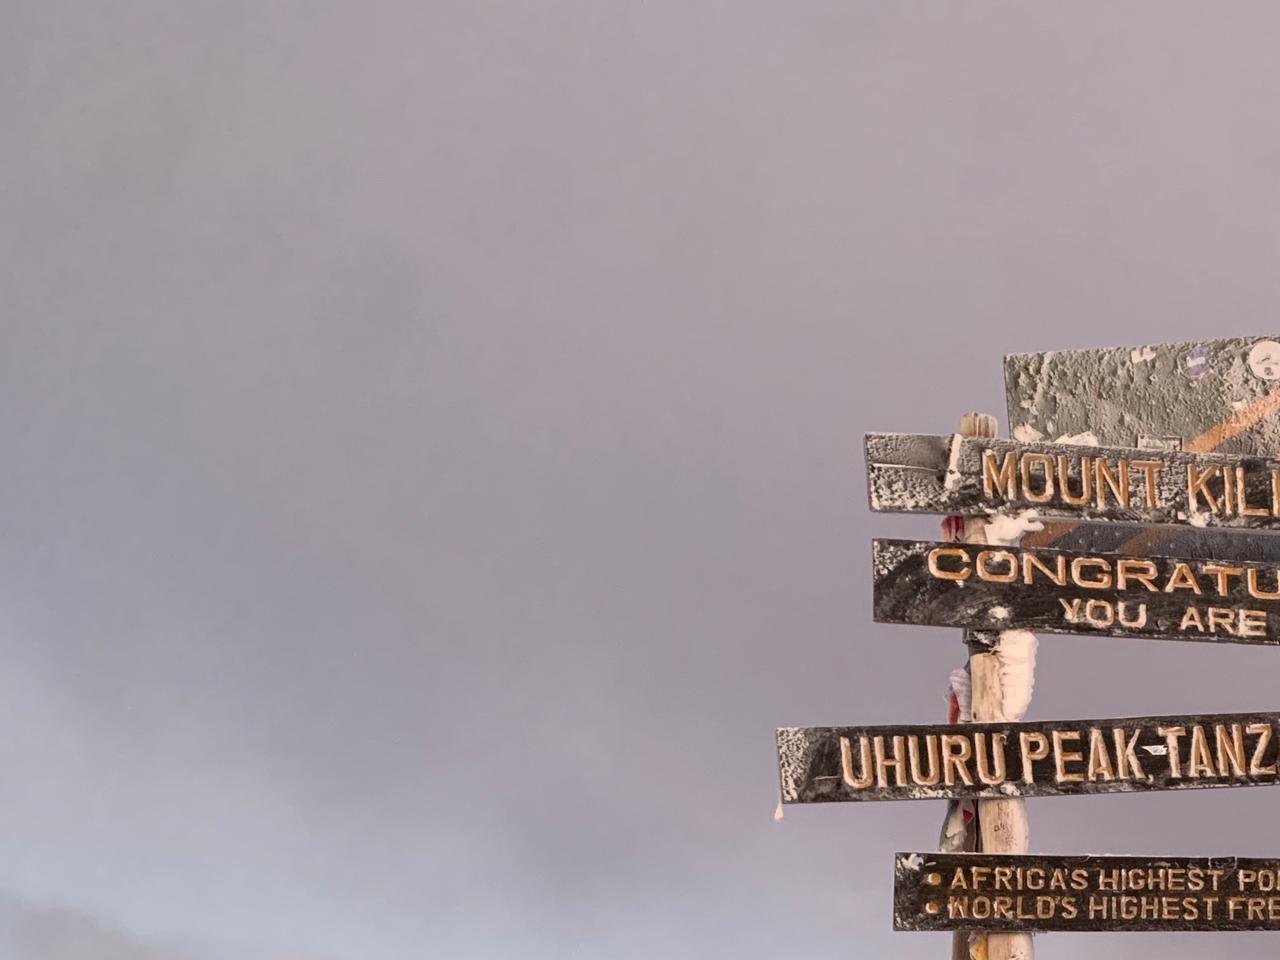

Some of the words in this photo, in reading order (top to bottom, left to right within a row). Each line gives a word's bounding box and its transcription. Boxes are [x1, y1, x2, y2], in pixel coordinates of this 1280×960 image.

[982, 449, 1167, 508] MOUNT
[1058, 598, 1147, 629] YOU
[1180, 606, 1267, 637] ARE
[839, 731, 1006, 789] UHURU
[1098, 867, 1226, 891] HIGHEST
[947, 895, 1079, 920] WORLD'S
[1088, 895, 1220, 921] HIGHEST
